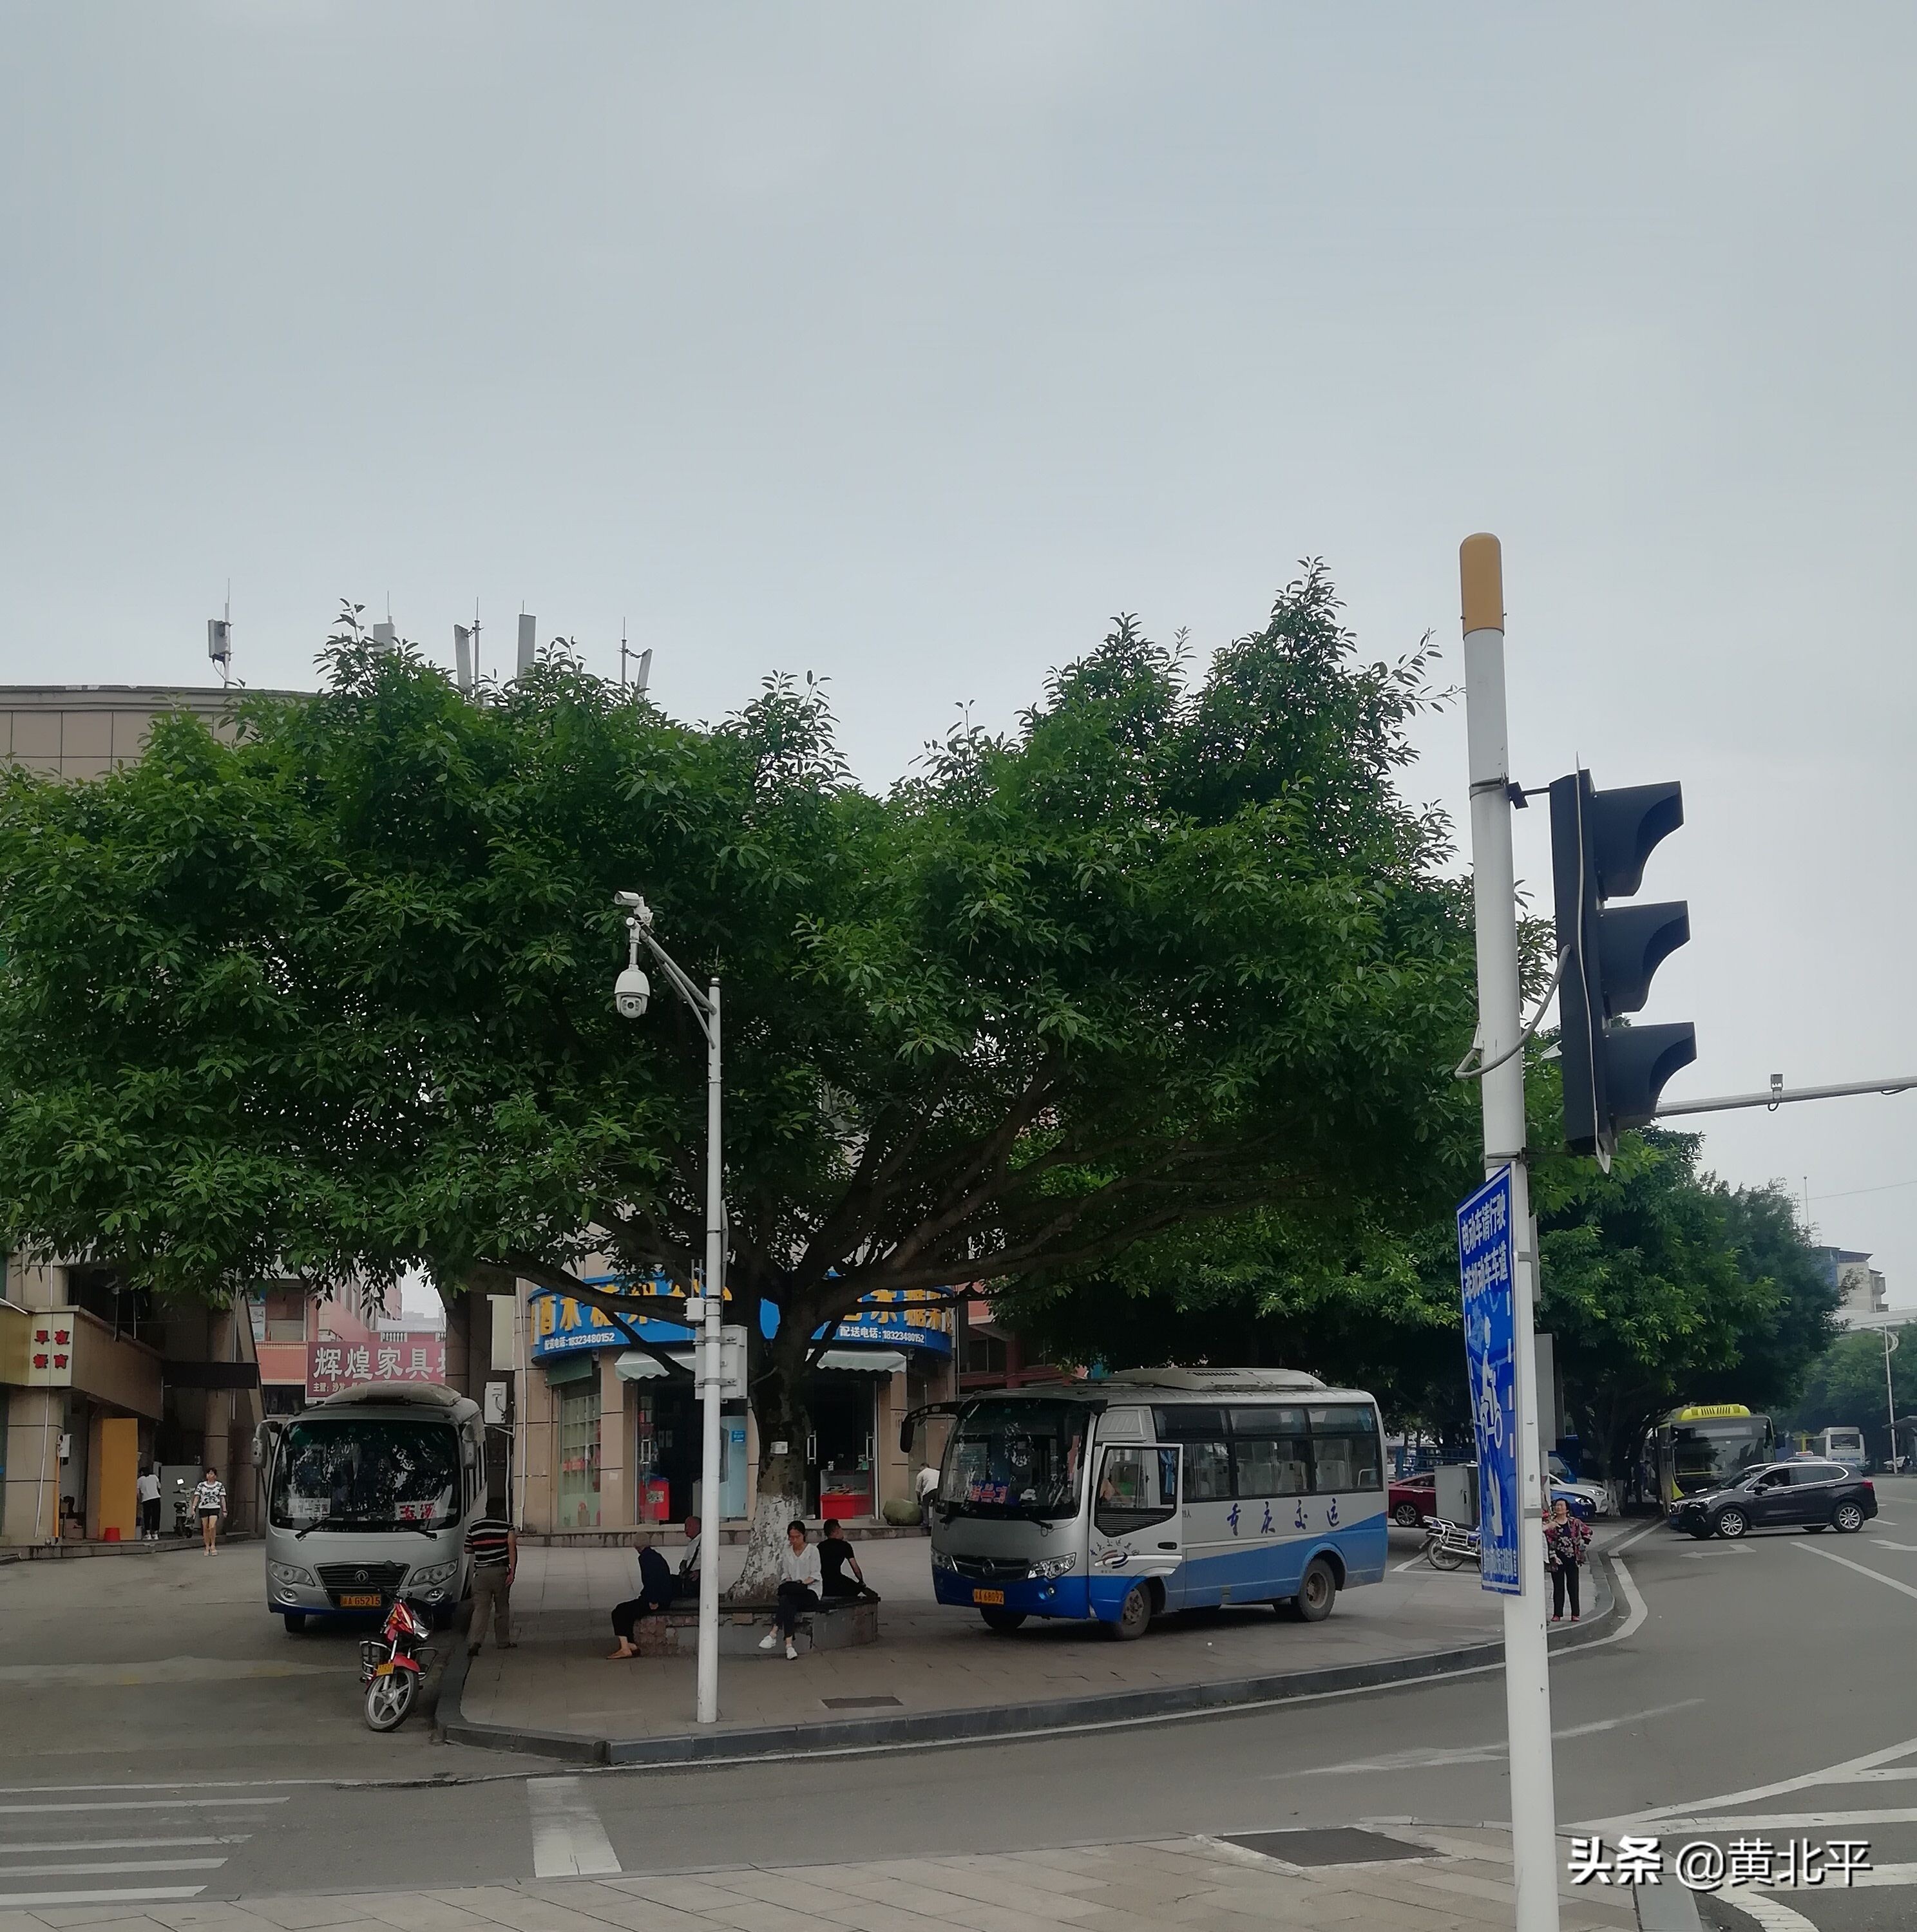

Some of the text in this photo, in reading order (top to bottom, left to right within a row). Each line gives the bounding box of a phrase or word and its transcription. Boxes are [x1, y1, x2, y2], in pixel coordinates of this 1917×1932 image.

[1462, 1189, 1506, 1255] 电动车请行驶
[1464, 1240, 1508, 1303] 非机动车车道
[1227, 1497, 1340, 1536] 重庆交运
